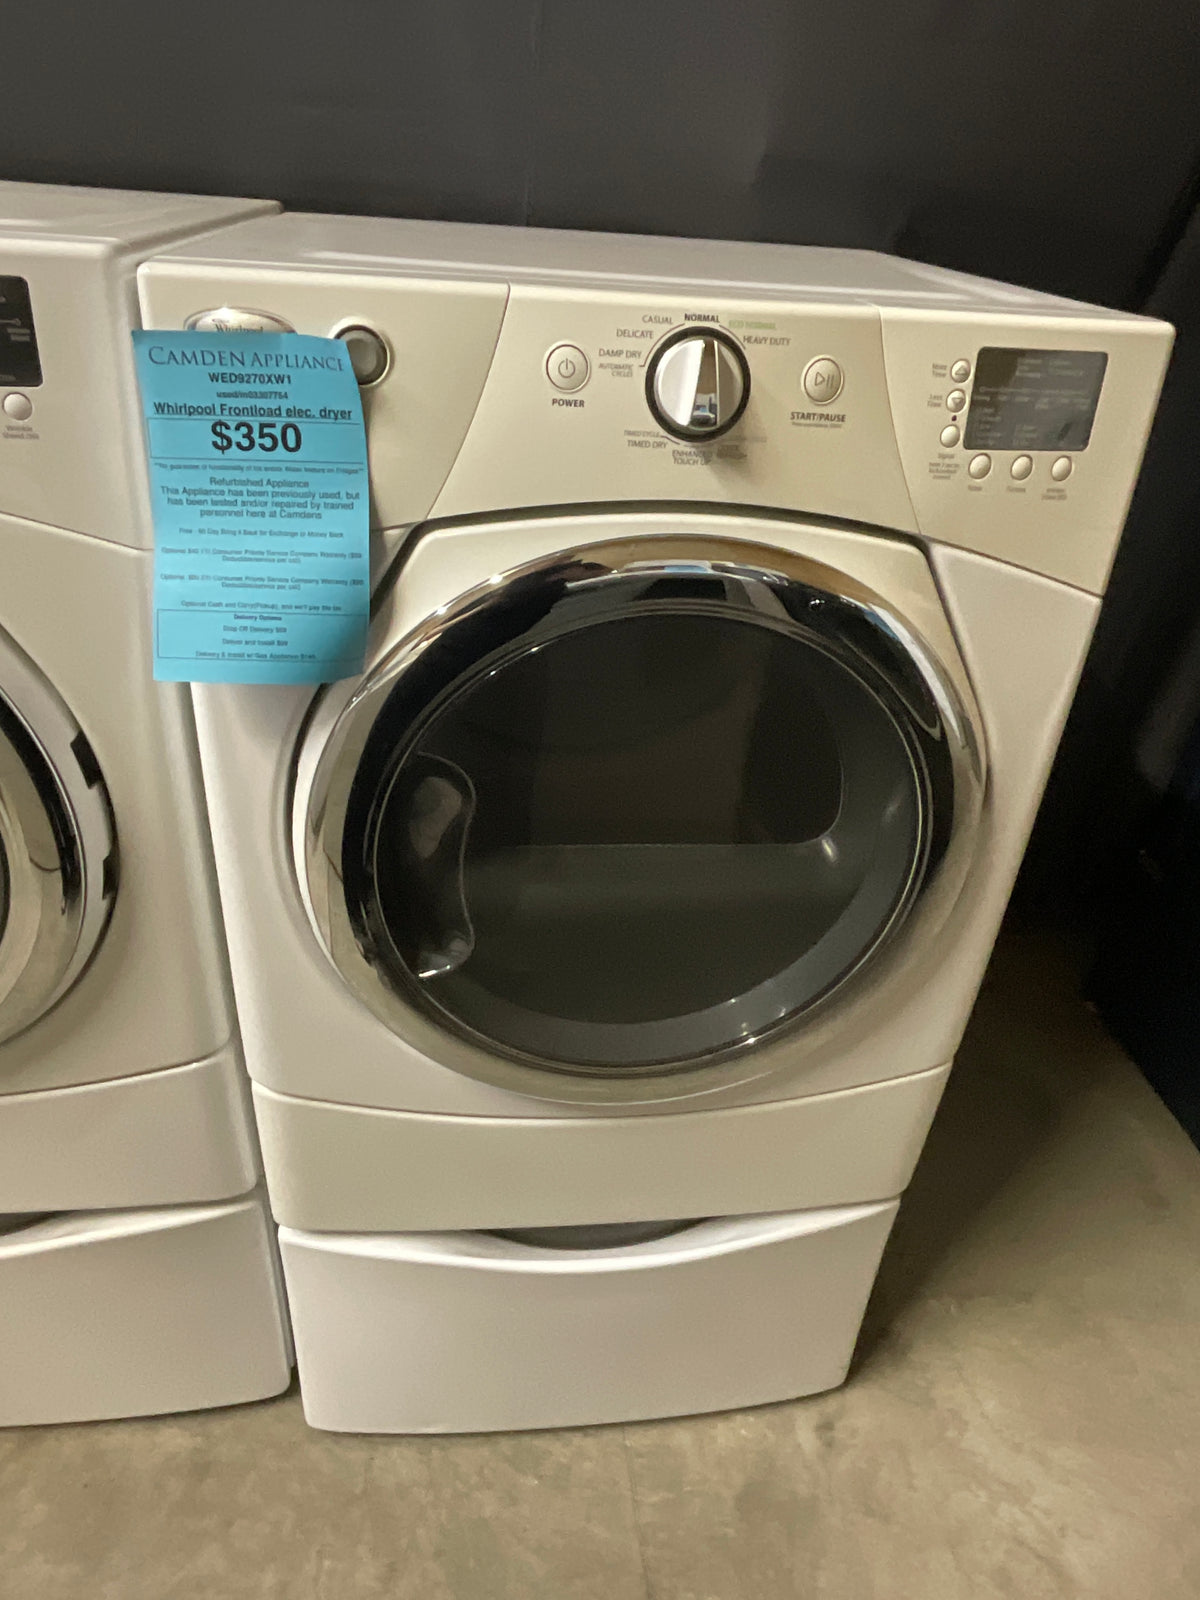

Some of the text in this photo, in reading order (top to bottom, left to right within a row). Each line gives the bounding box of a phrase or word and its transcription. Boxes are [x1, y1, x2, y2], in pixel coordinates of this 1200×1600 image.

[642, 315, 673, 324] CASUAL
[684, 313, 720, 323] NORMAL
[616, 329, 654, 339] DELICATE
[743, 335, 791, 346] HEAVY DUTY
[148, 346, 245, 366] CAMDEN
[598, 348, 642, 359] DAMP DRY
[208, 372, 291, 384] WED9270XW1
[551, 398, 585, 408] POWER
[153, 402, 352, 421] Whirlpool Frontload elec. dryer
[790, 411, 847, 423] START/PAUSE
[211, 420, 302, 453] $350
[627, 440, 668, 449] TIMED DRY
[209, 477, 309, 489] Refurbished Appliance
[161, 486, 179, 495] This
[182, 487, 225, 497] Appliance
[228, 488, 243, 497] has
[247, 489, 269, 498] been
[271, 490, 315, 500] previously
[346, 491, 360, 500] but
[186, 498, 208, 506] been
[211, 498, 238, 507] tested
[271, 500, 308, 510] repaired
[310, 501, 321, 511] by
[323, 502, 354, 510] trained
[200, 509, 243, 518] personnel
[246, 509, 266, 518] here
[269, 510, 277, 518] at
